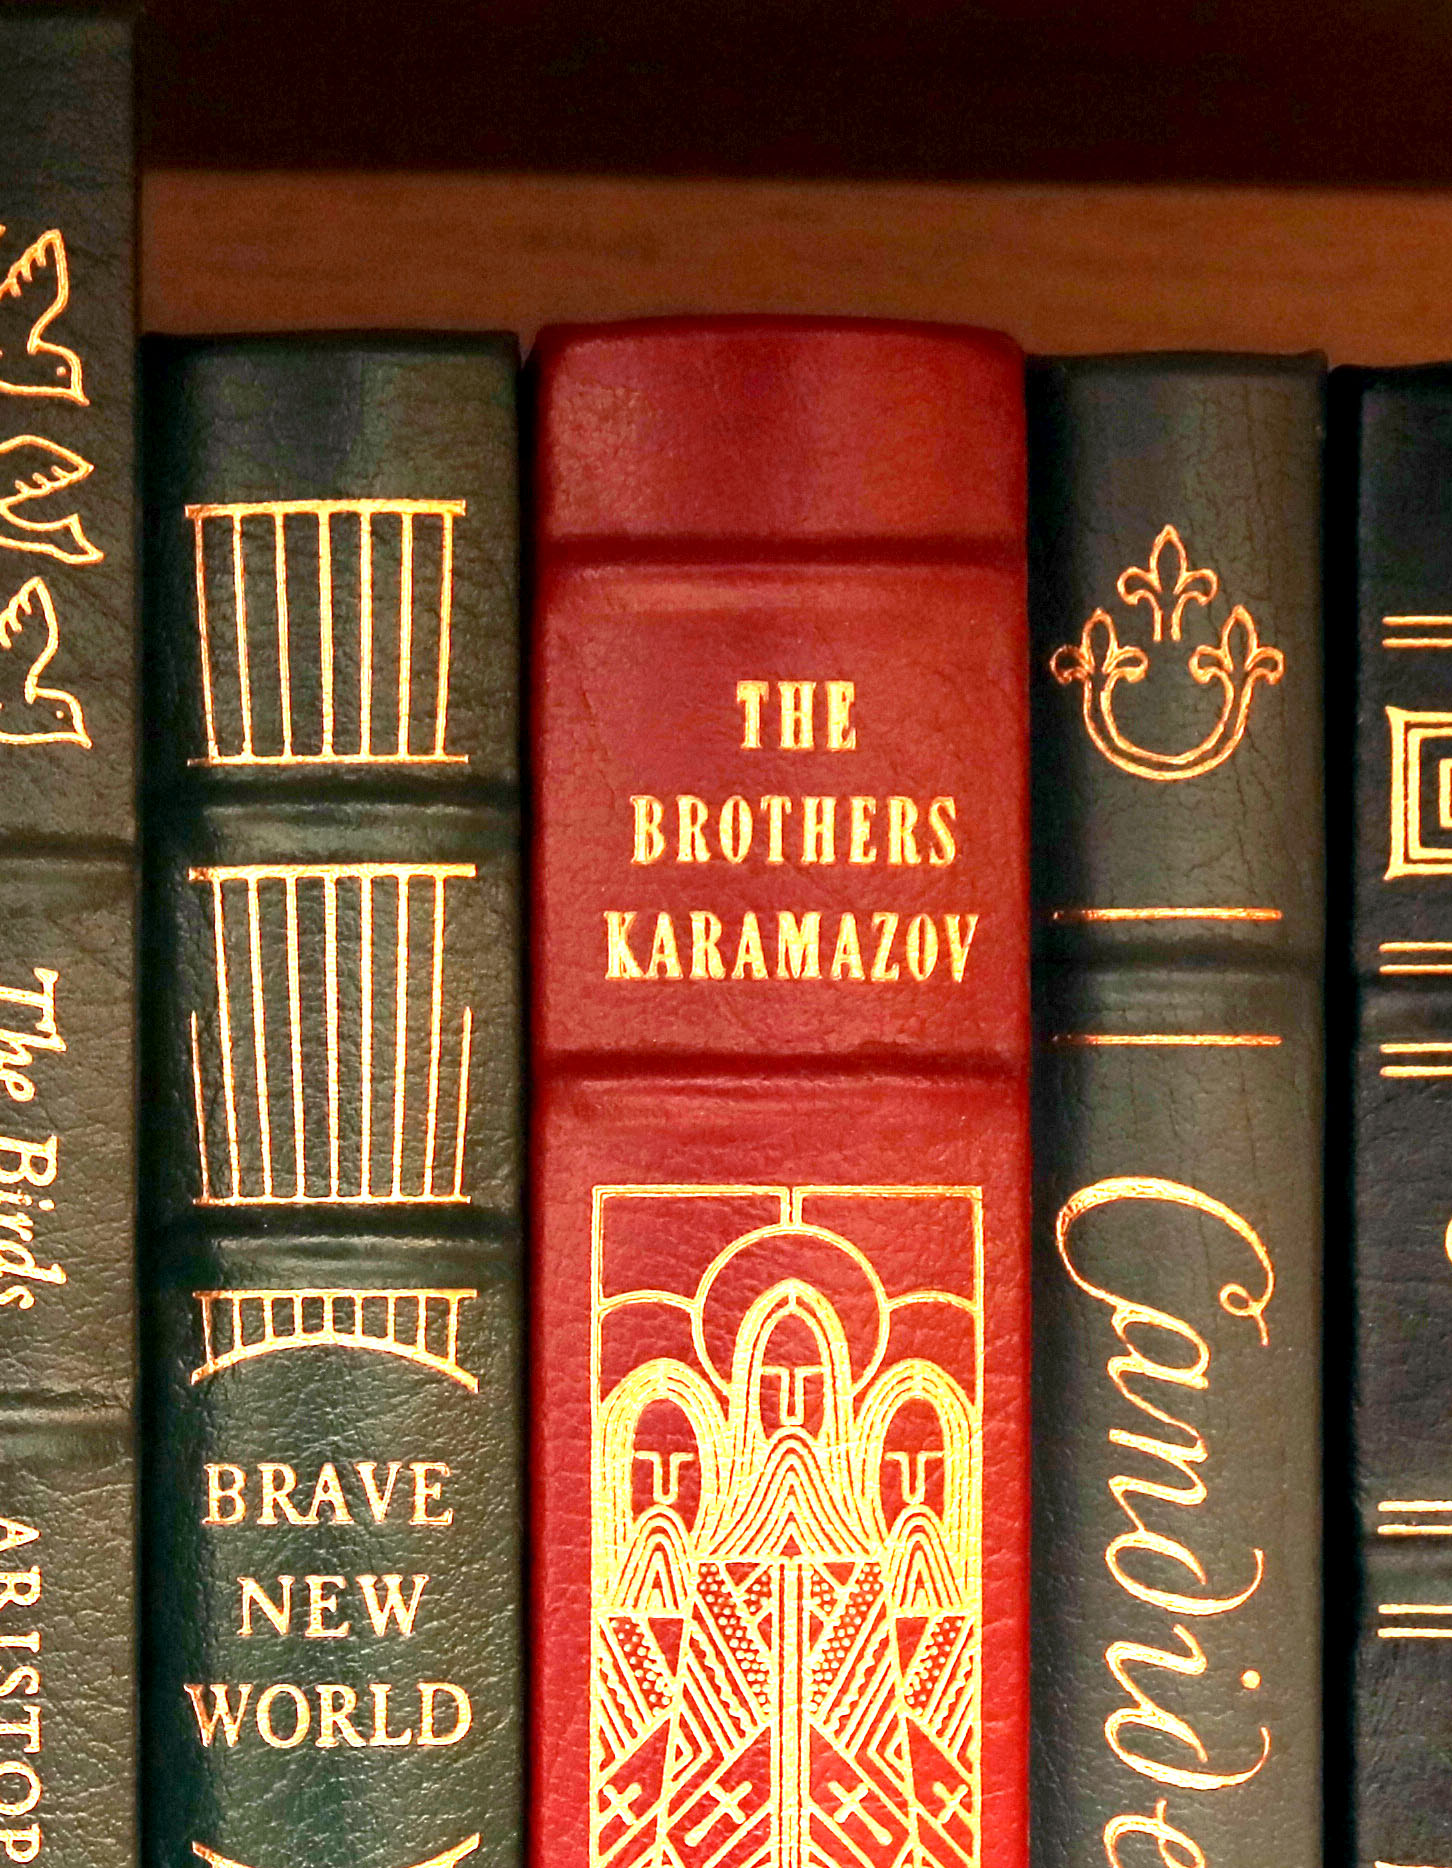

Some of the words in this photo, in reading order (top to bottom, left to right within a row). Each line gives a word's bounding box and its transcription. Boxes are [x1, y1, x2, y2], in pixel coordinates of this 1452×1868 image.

[734, 678, 859, 754] THE
[627, 792, 958, 869] BROTHERS
[601, 908, 981, 985] KARAMAZOV
[199, 1459, 456, 1529] BRAVE
[234, 1571, 432, 1644] NEW
[181, 1680, 474, 1751] WORLD
